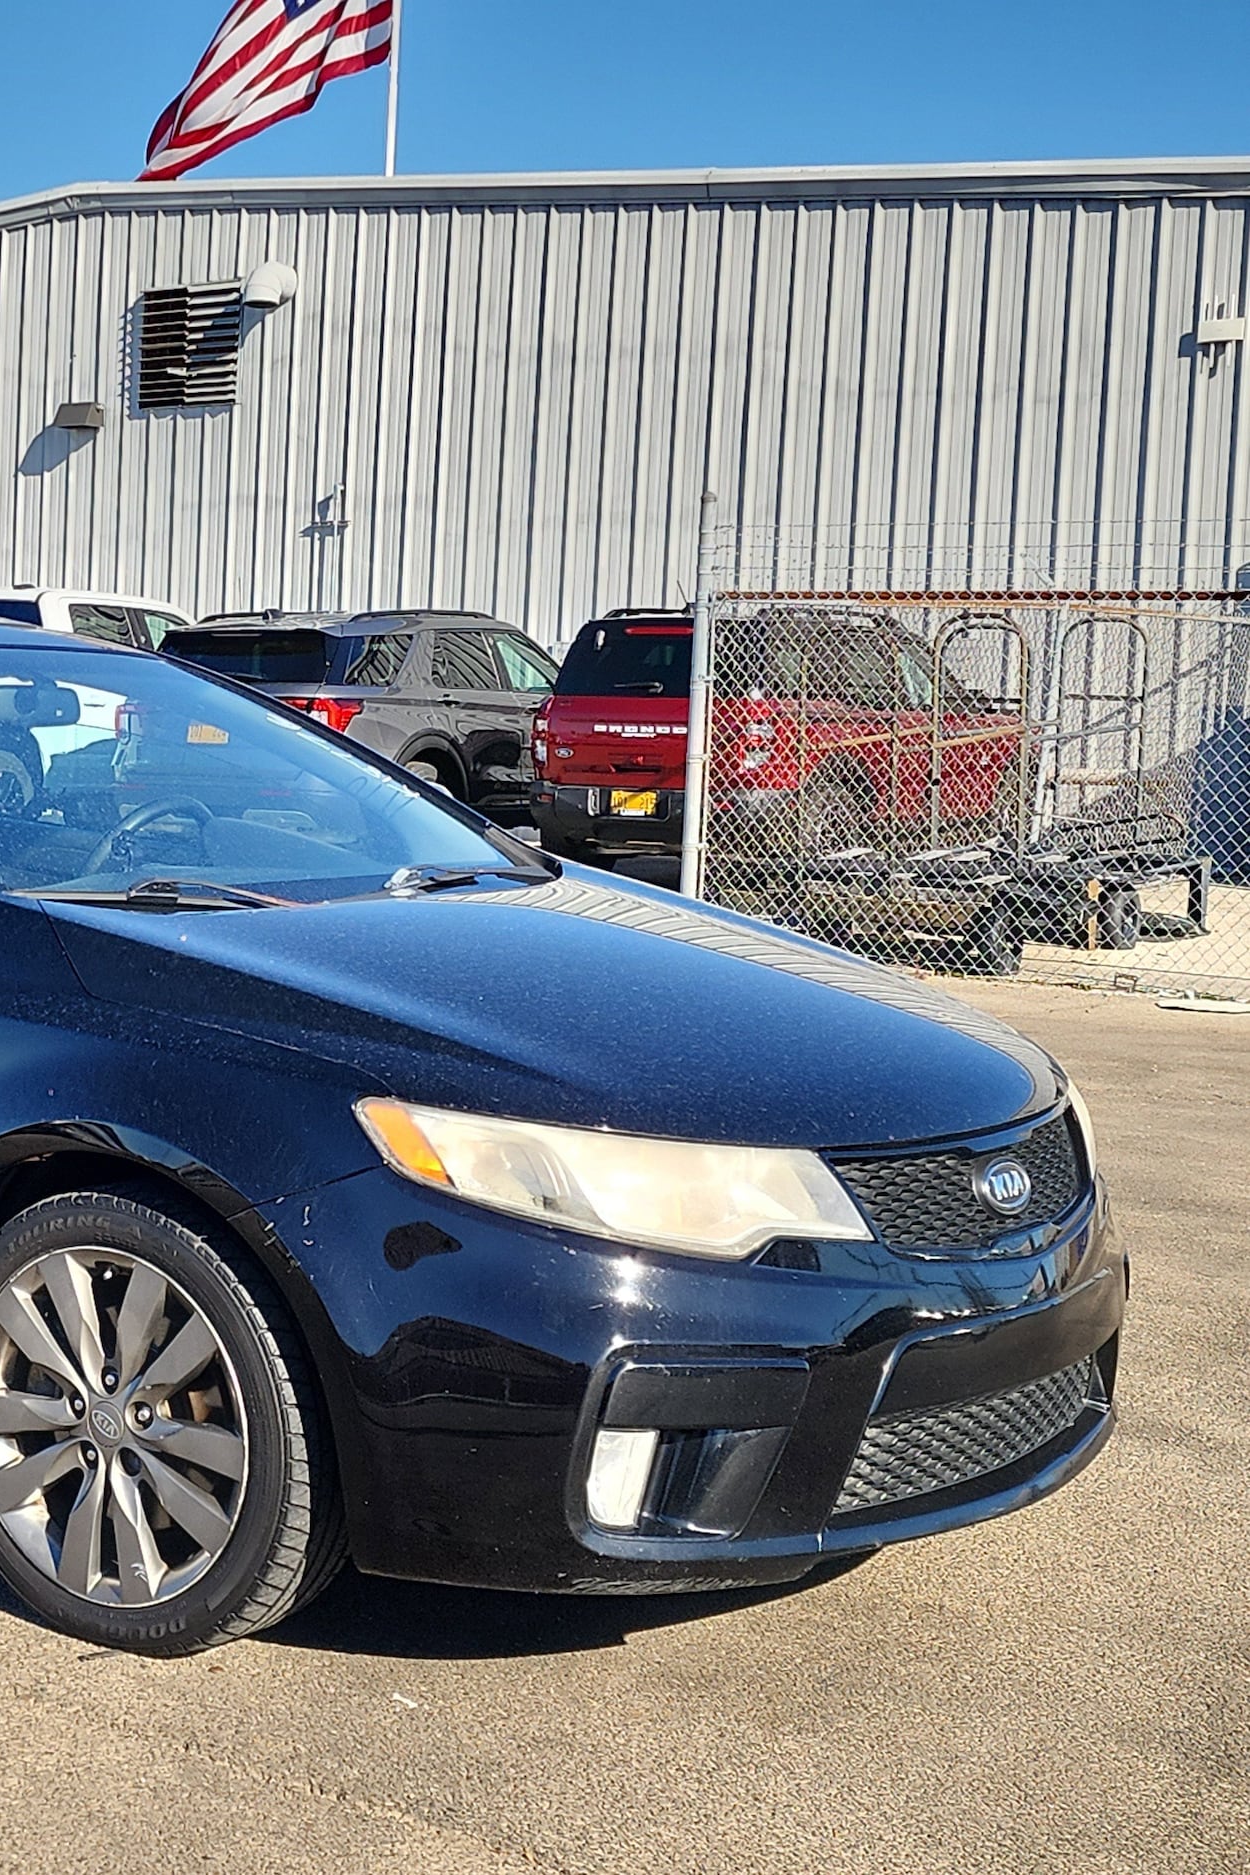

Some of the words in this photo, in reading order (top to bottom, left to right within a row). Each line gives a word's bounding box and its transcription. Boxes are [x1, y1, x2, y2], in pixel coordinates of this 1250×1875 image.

[989, 1171, 1025, 1201] KIA
[6, 1213, 111, 1254] TOURING
[95, 1412, 116, 1437] KIA
